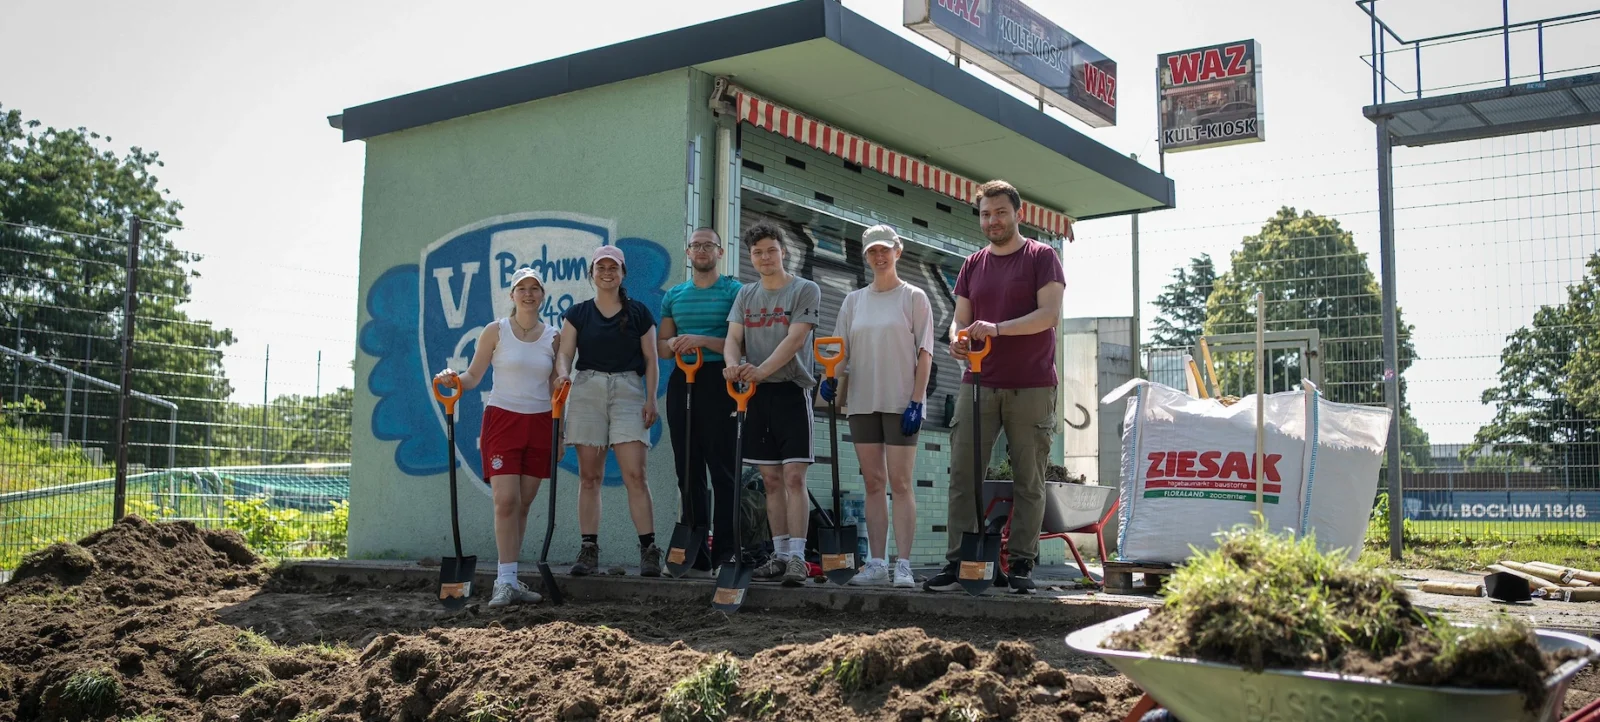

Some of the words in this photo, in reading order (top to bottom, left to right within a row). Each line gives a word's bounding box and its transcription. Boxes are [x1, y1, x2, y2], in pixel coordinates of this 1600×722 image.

[1002, 15, 1063, 73] KULT-KIOSK
[1167, 44, 1247, 86] WAZ
[1083, 60, 1116, 108] WAZ
[1164, 118, 1256, 145] KULT-KIOSK
[1146, 451, 1282, 482] ZIESAK
[1164, 490, 1205, 498] FLORALAND
[1209, 492, 1247, 500] zoocenter
[1460, 503, 1541, 518] BOCHUM
[1544, 503, 1587, 518] 1848
